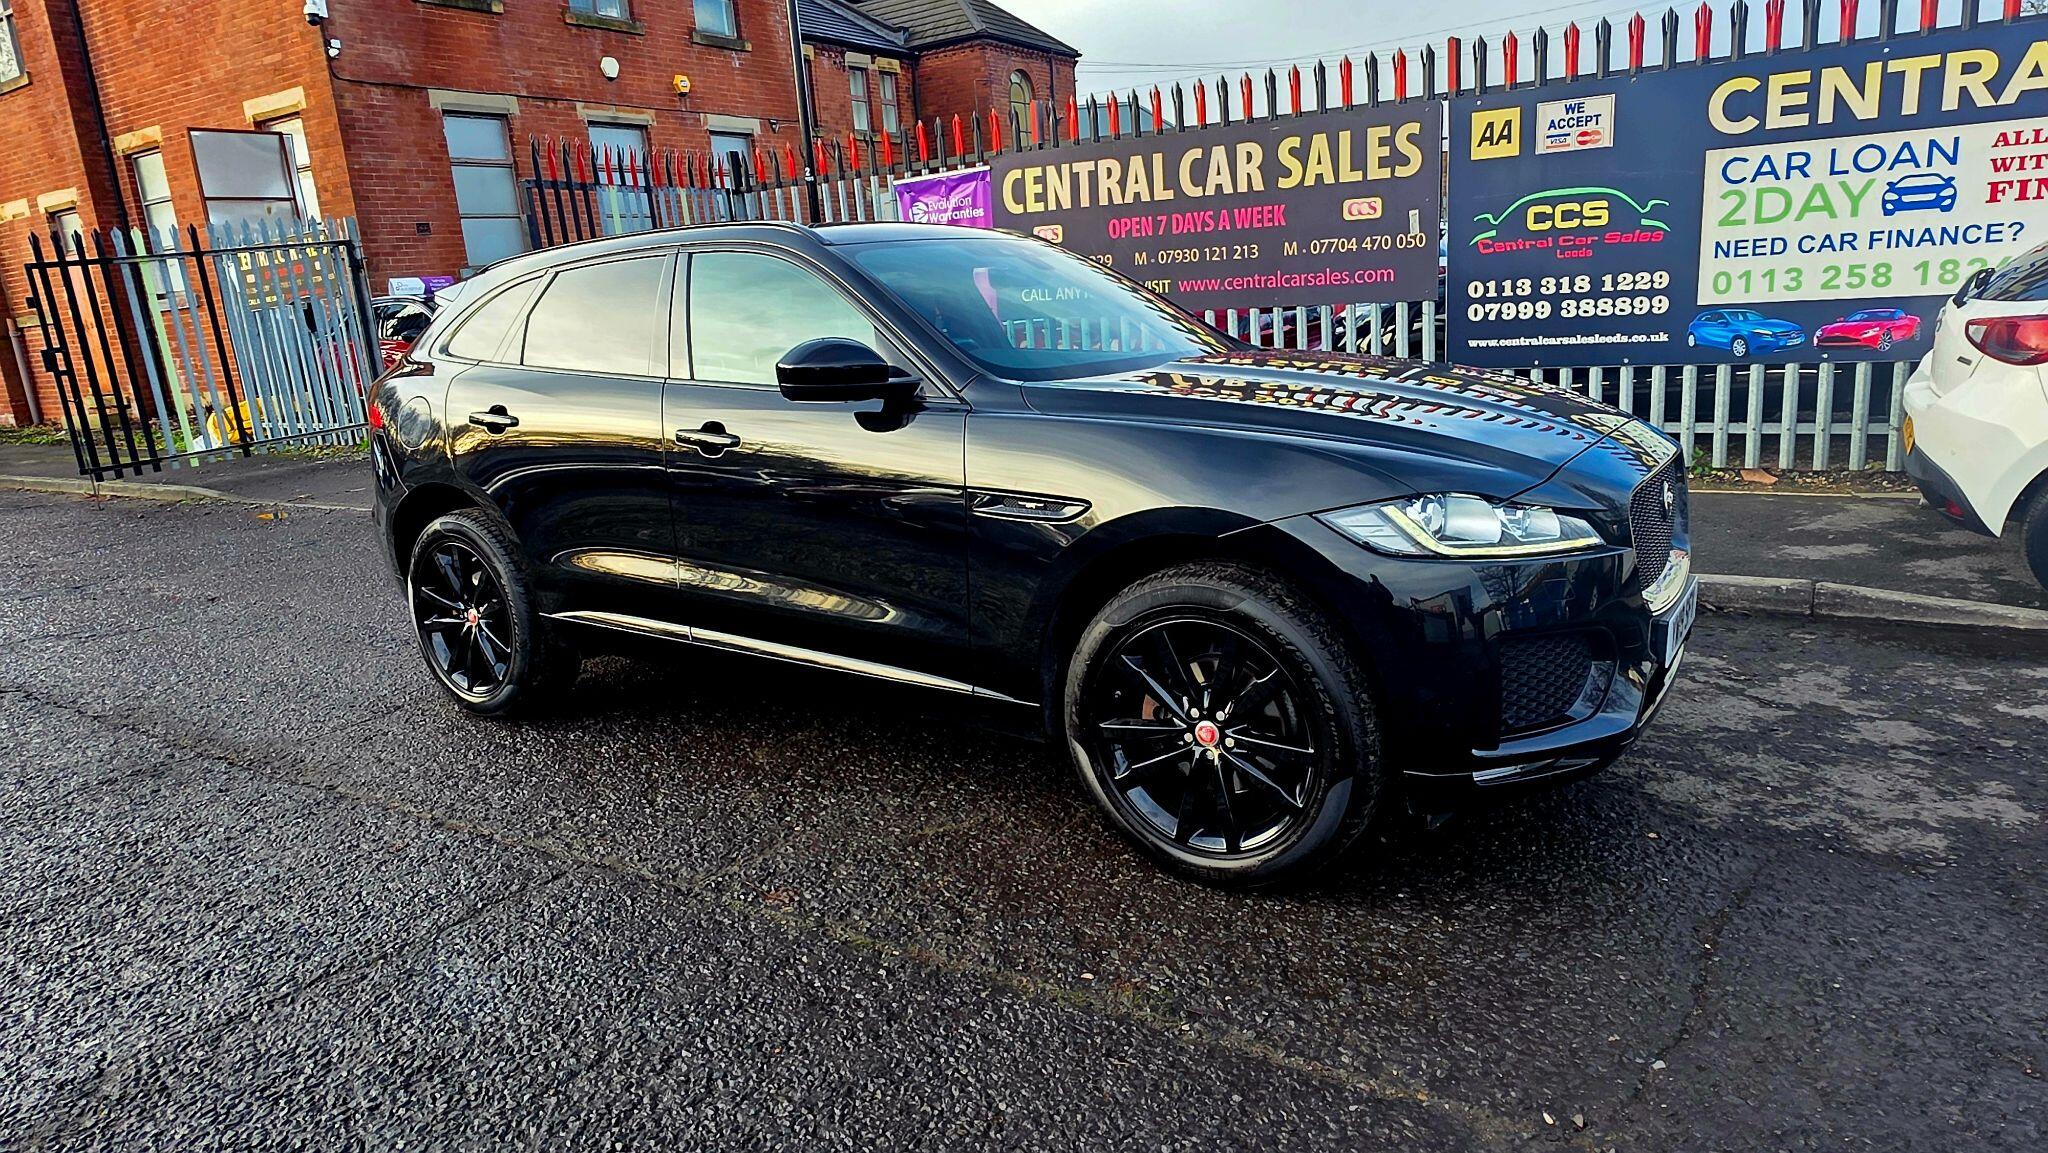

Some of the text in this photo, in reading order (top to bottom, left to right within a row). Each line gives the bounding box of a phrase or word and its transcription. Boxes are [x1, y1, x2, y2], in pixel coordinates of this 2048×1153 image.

[1547, 114, 1601, 131] ACCEPT
[1564, 102, 1585, 115] WE
[1476, 119, 1513, 147] AA
[1550, 137, 1567, 145] VISA
[1002, 122, 1424, 215] CENTRAL CAR SALES
[1721, 136, 1960, 185] CAR LOAN
[928, 195, 972, 212] Evolution
[928, 206, 984, 223] Warranties
[1526, 200, 1609, 231] CCS
[1718, 178, 1876, 227] 2DAY
[1108, 204, 1286, 239] OPEN 7 DAYS A WEEK
[1158, 247, 1199, 264] 07930
[1203, 247, 1227, 261] 121
[1233, 244, 1259, 259] 213
[1310, 237, 1357, 254] 07704
[1362, 235, 1392, 251] 470
[1396, 232, 1427, 249] 050
[1477, 229, 1665, 254] Central Car Sales
[1556, 249, 1593, 259] Leeds
[1714, 221, 2025, 259] NEED CAR FINANCE?
[1021, 288, 1052, 302] CALL
[1179, 267, 1395, 292] www.centralcarsales.com
[1467, 270, 1670, 298] 0113 318 1229
[1712, 266, 1804, 295] 0113
[1820, 262, 1893, 290] 258
[1467, 295, 1670, 322] 07999 388899
[1467, 331, 1669, 348] www.centralcarsalesleeds.co.uk
